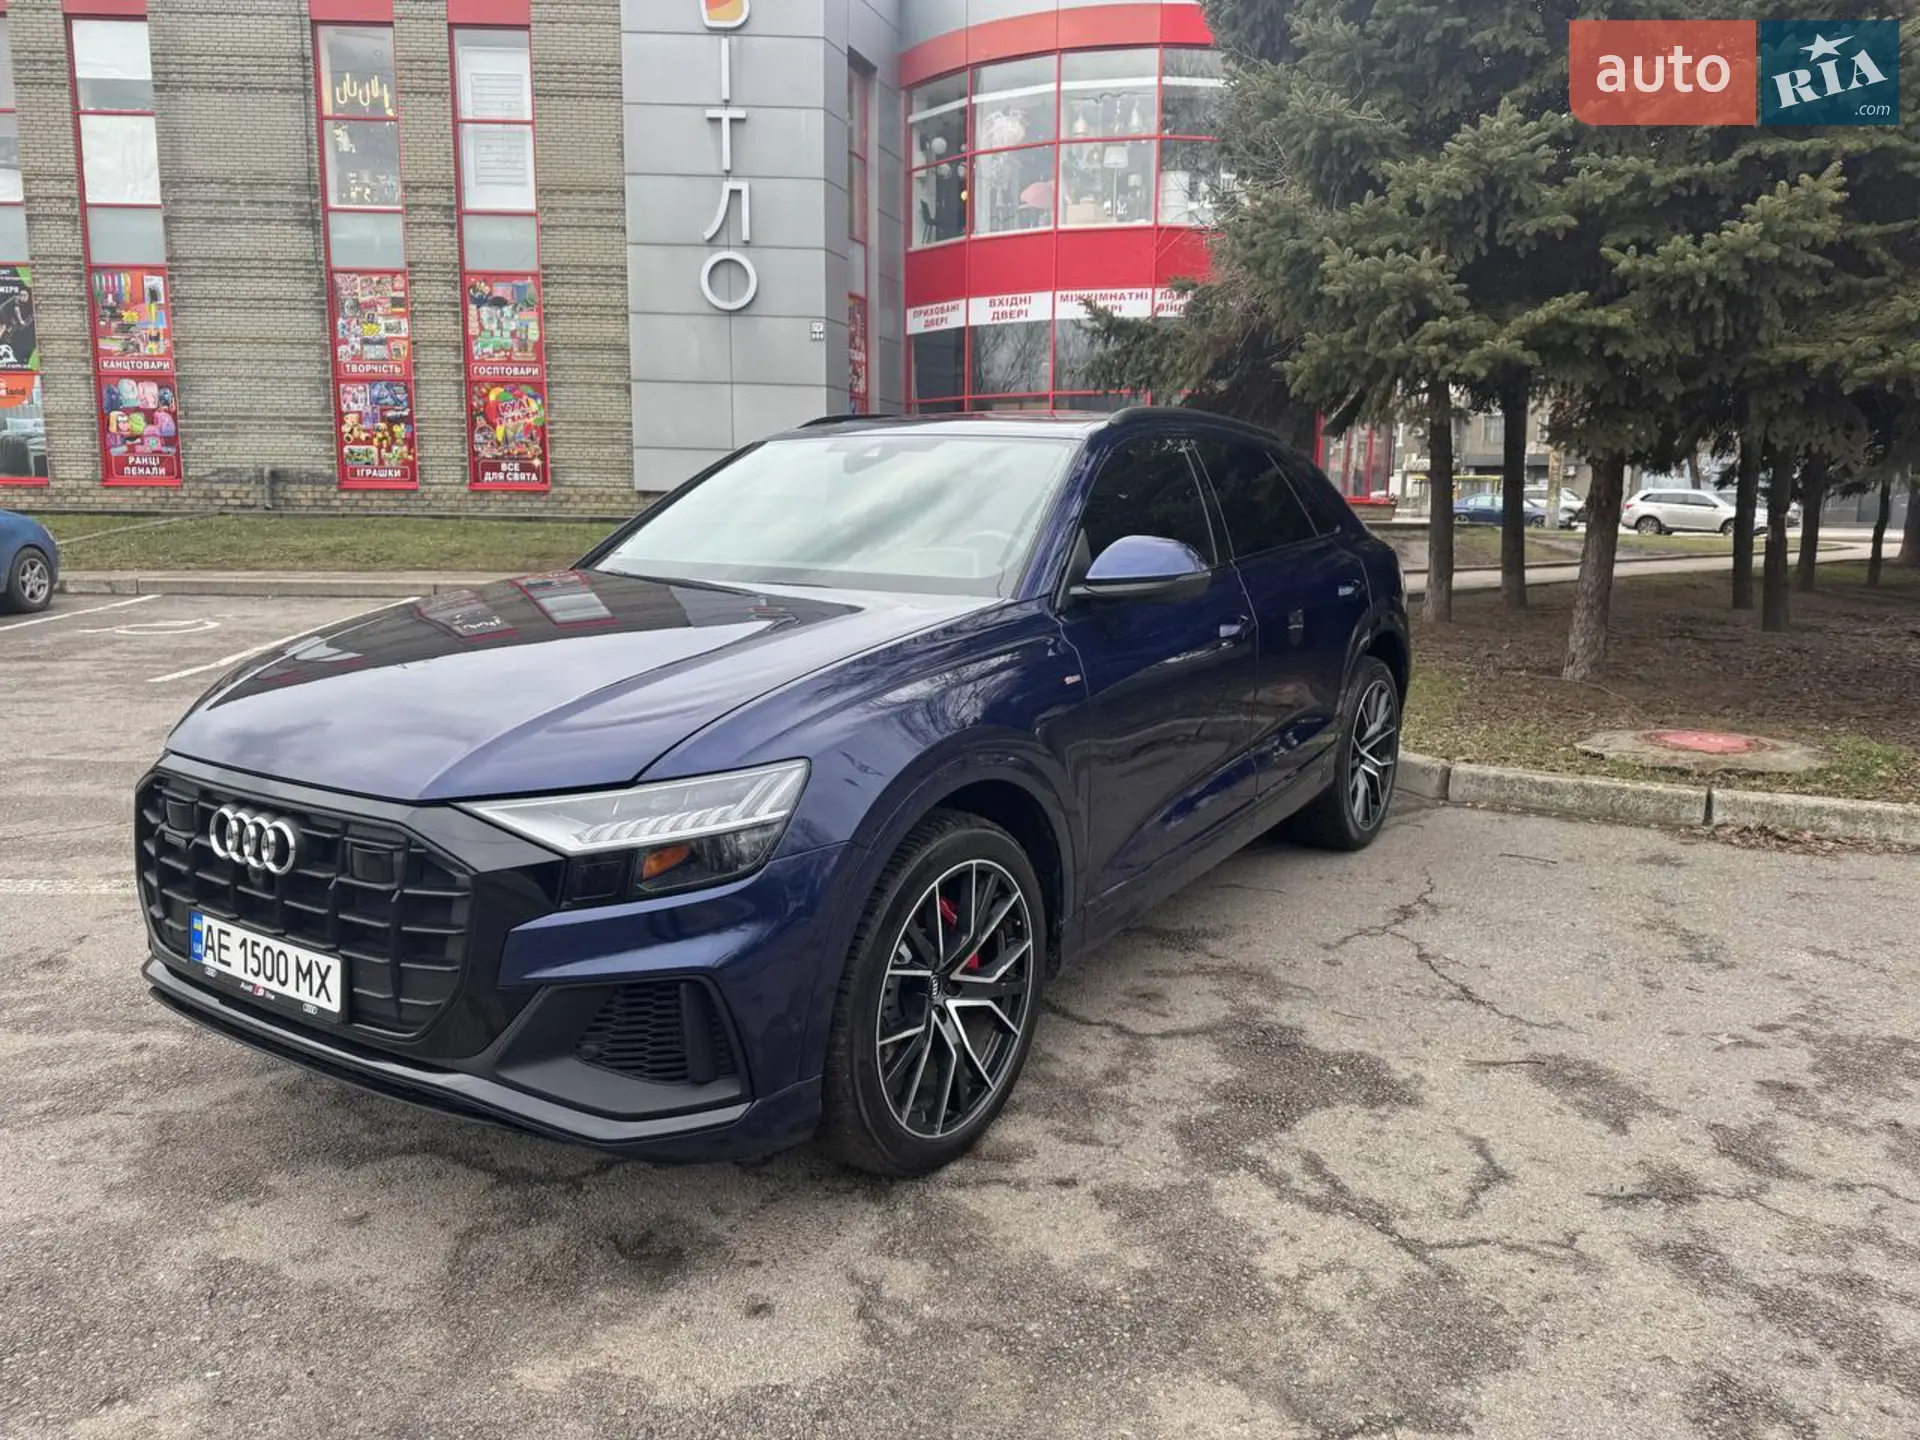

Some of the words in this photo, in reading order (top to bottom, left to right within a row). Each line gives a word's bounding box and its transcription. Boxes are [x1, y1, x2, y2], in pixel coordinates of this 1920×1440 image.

[989, 295, 1032, 308] ВХІДНІ
[913, 304, 960, 318] ПРИХОВАНІ
[991, 310, 1028, 322] ДВЕРІ
[924, 316, 948, 329] ДВЕРІ
[103, 361, 170, 371] КАНЦТОВАРИ
[345, 364, 401, 373] ТВОРЧІСТЬ
[473, 366, 539, 376] ГОСПТОВАРИ
[128, 456, 160, 466] РАНЦІ
[124, 466, 166, 475] ПЕНАЛИ
[501, 462, 520, 471] ВСЕ
[356, 469, 401, 477] ІГРАШКИ
[484, 472, 505, 481] ДЛЯ
[506, 472, 538, 481] СВЯТА
[203, 924, 232, 968] AE
[239, 937, 289, 988] 1500
[295, 954, 332, 1004] MX
